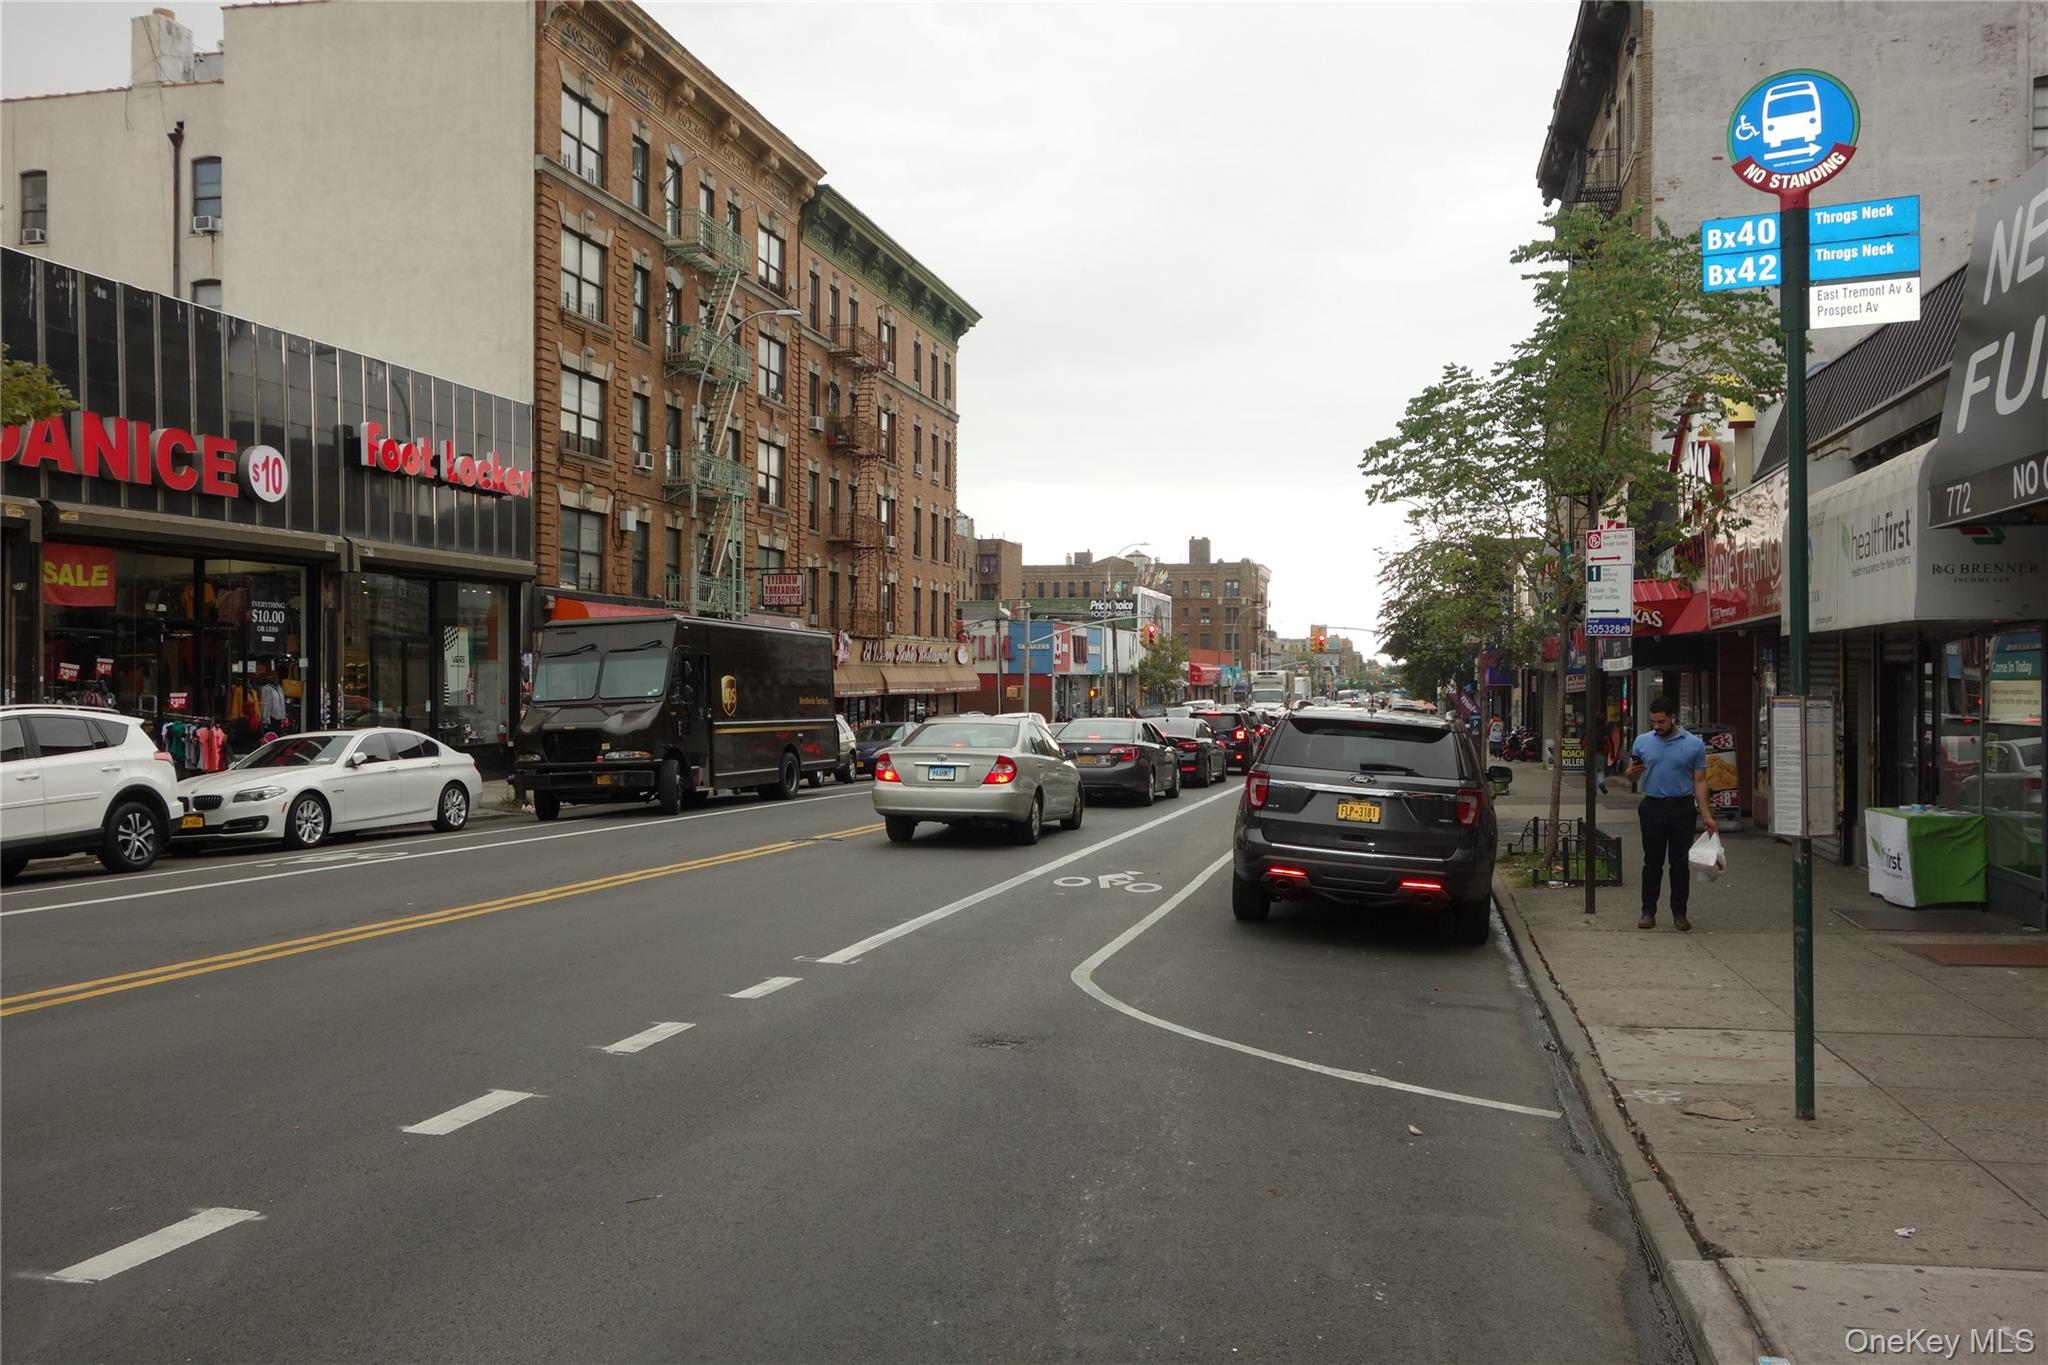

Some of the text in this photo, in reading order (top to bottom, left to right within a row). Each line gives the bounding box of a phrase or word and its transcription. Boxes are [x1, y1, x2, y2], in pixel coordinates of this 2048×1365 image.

[1743, 152, 1847, 189] NO STANDING
[1815, 204, 1894, 225] Throgs Neck
[1707, 218, 1776, 250] Bx40
[1815, 242, 1894, 262] Throgs Neck
[1708, 254, 1777, 286] Bx42
[1817, 282, 1913, 301] East Tremont Av &
[1817, 302, 1879, 317] Prospect Av
[1956, 315, 2048, 434] FU
[361, 422, 533, 498] Foot Locker
[1946, 482, 1971, 517] 772
[2013, 460, 2039, 499] NO
[1851, 509, 1911, 562] healthfirst
[43, 560, 108, 587] SALE
[1592, 566, 1597, 581] 1
[1960, 562, 2039, 575] BRENNER
[767, 576, 798, 585] EYEBROW
[765, 586, 801, 595] THREADING
[251, 600, 286, 609] EVERYTHING
[252, 609, 285, 624] $10.00
[1587, 624, 1621, 634] 205328
[1561, 750, 1585, 758] ROACH
[1562, 758, 1585, 767] KILLER
[1341, 805, 1376, 818] FLP-3181
